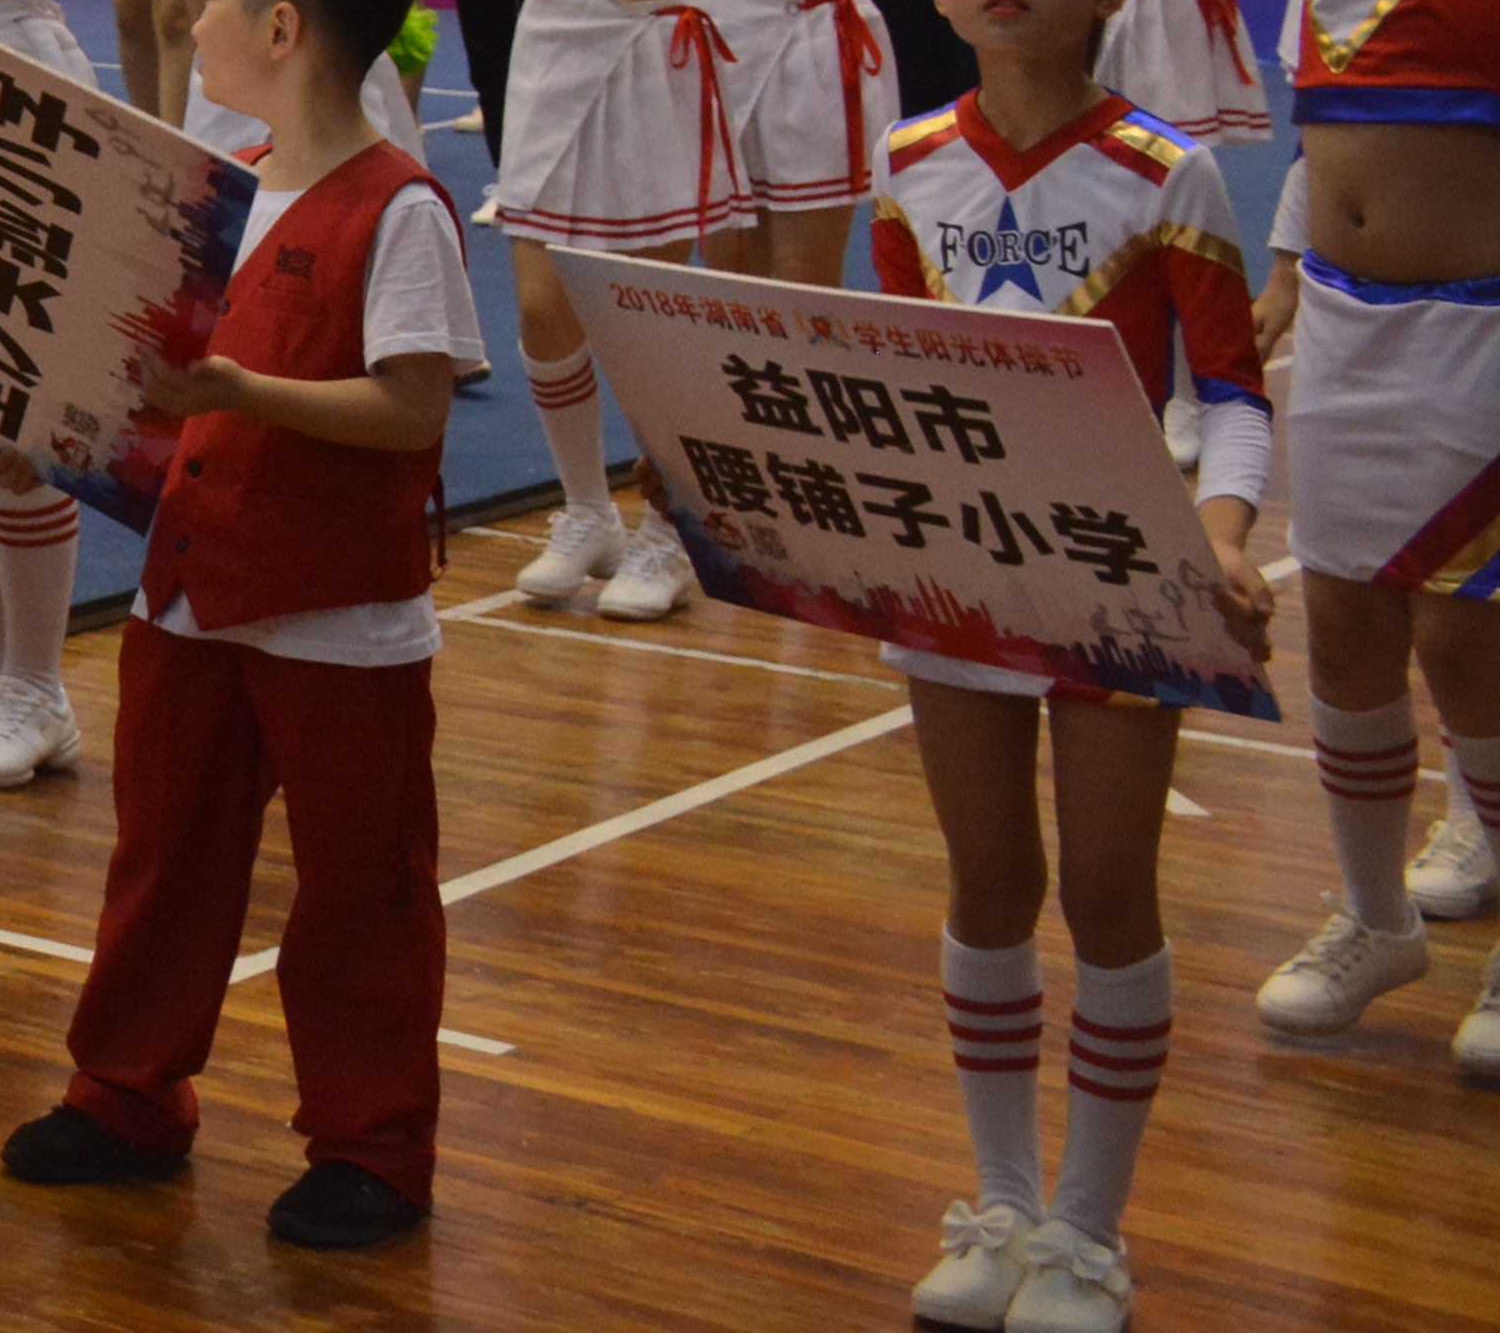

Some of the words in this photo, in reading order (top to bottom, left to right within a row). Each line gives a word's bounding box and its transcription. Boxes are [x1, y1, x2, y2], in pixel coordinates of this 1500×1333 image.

[935, 220, 1092, 277] FORCE
[608, 282, 787, 339] 2018年湖南省
[851, 320, 1086, 380] 学生阳光体操节
[720, 352, 1008, 467] 益阳市
[678, 434, 1160, 589] 腰铺子小学
